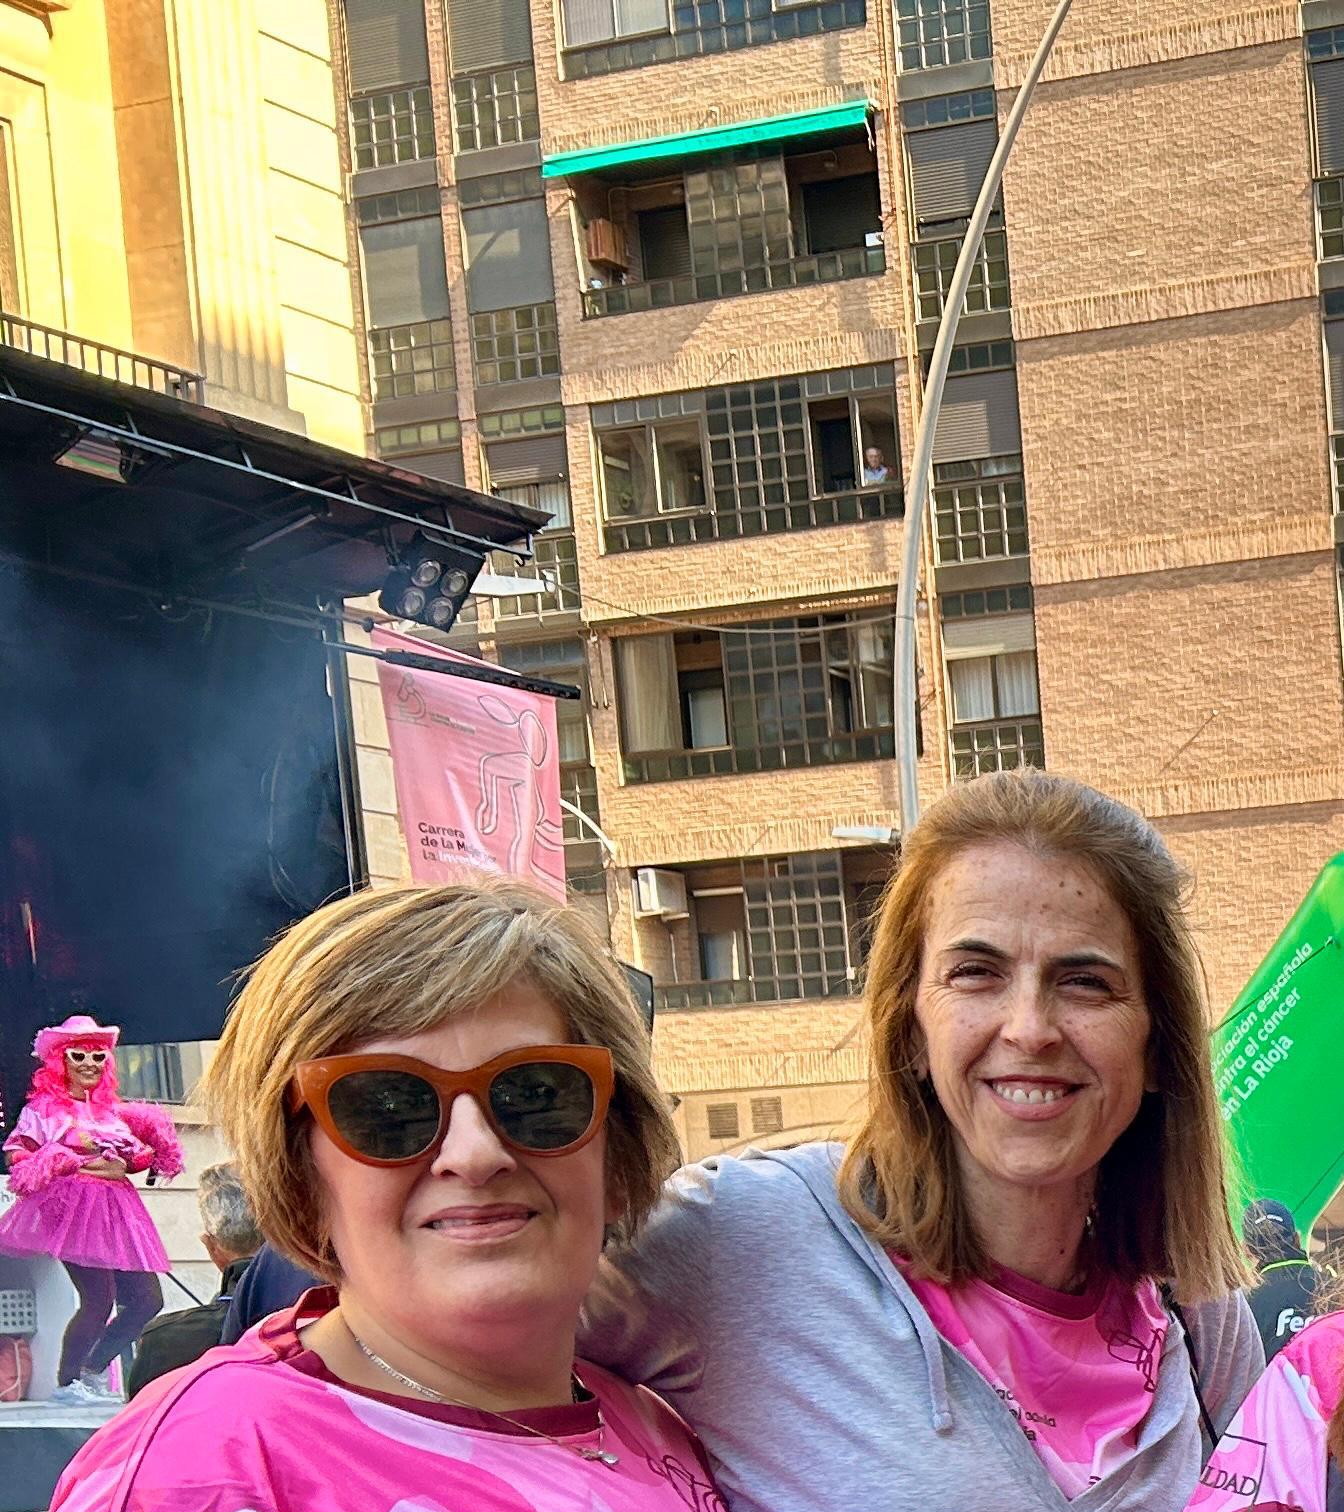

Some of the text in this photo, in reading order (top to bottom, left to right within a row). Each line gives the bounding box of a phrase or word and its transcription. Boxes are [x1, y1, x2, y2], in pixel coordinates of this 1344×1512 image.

[418, 822, 465, 839] Carrera
[421, 835, 454, 850] de la
[1256, 942, 1313, 1012] española
[1244, 987, 1301, 1057] el cáncer
[1221, 1034, 1294, 1121] en La Rioja
